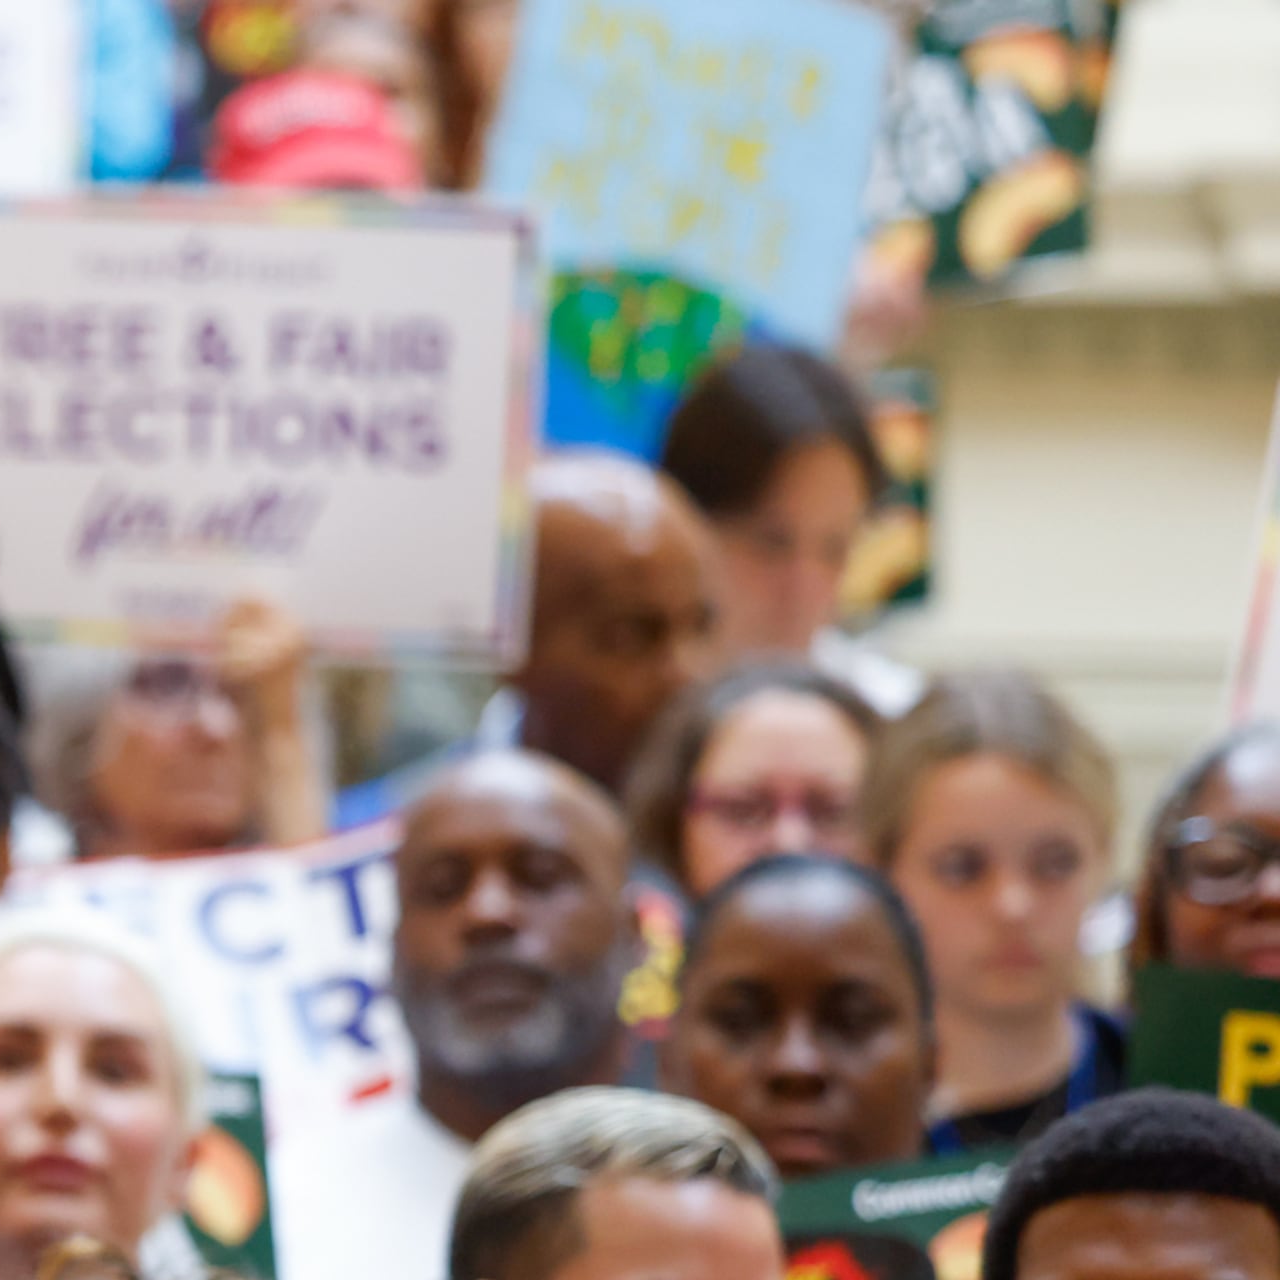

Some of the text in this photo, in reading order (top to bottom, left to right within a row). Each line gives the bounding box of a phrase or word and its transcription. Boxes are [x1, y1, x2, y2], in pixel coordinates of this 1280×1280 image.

[190, 304, 237, 371] &
[267, 304, 452, 375] FAIR
[72, 474, 171, 572] for
